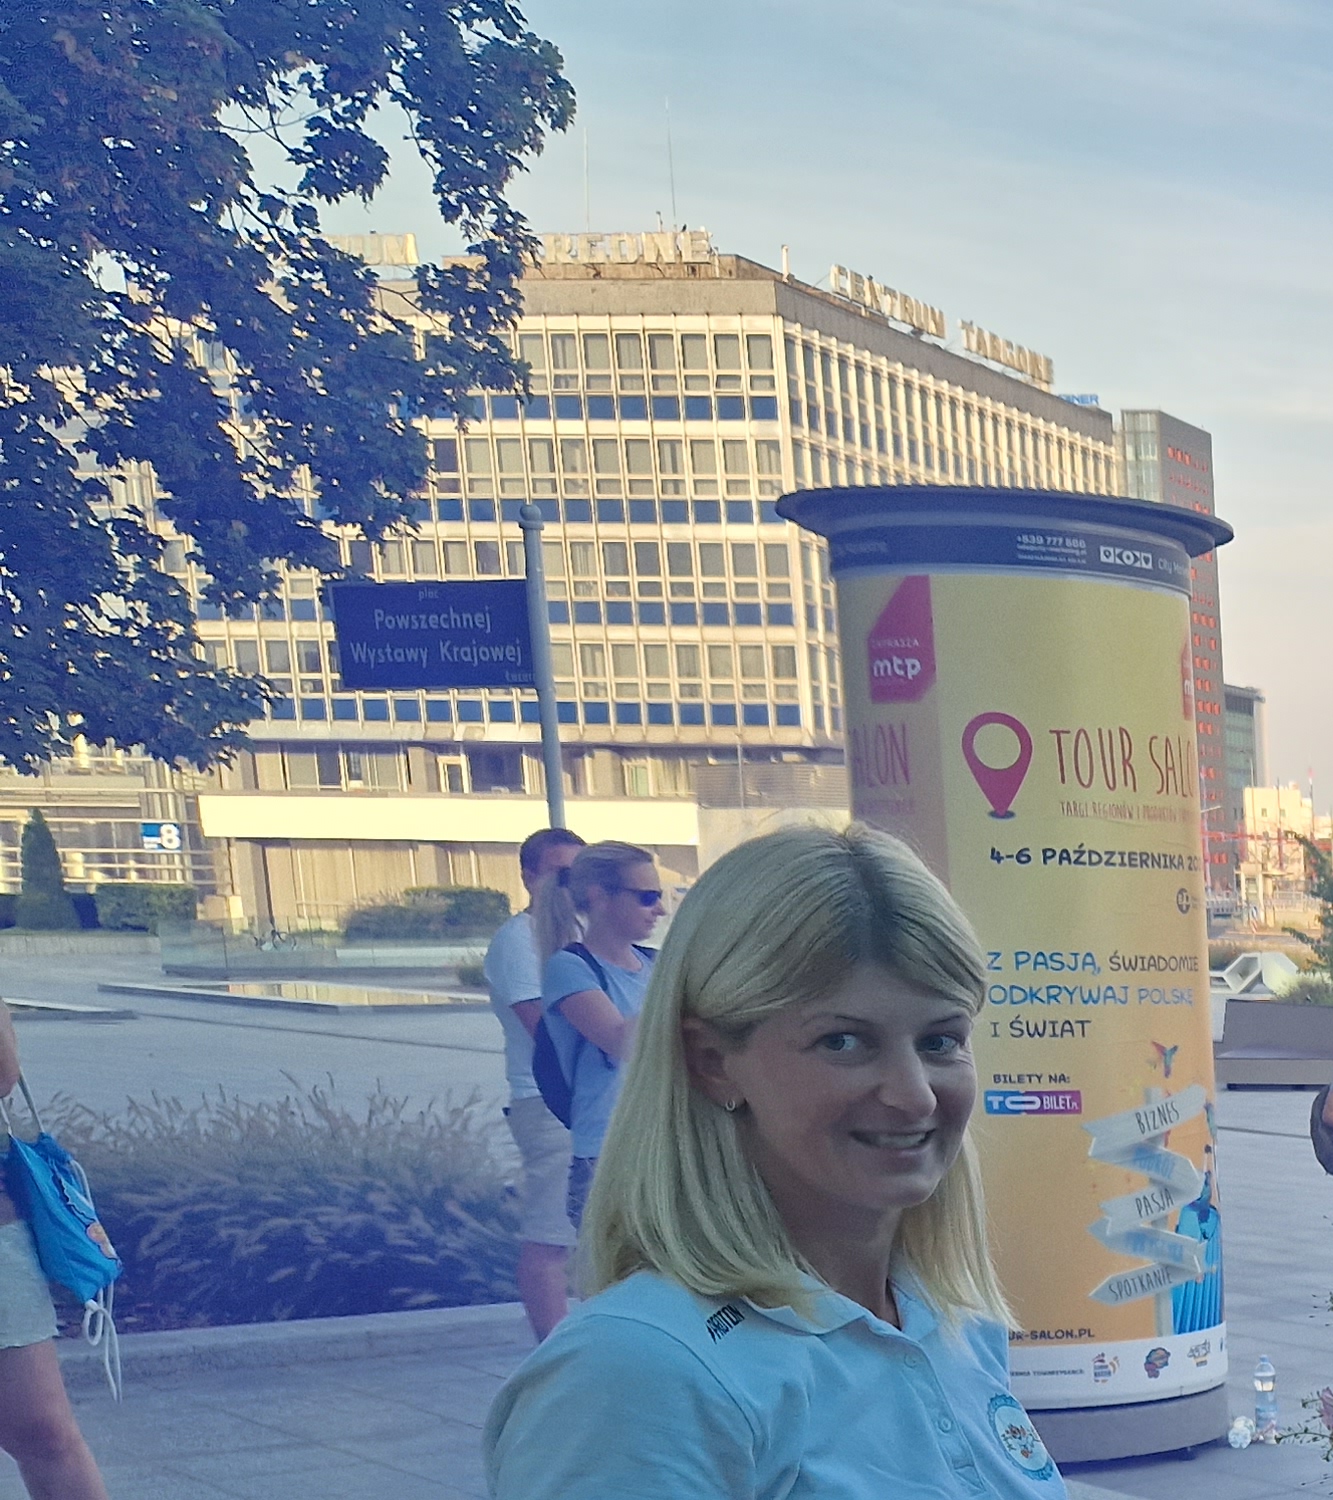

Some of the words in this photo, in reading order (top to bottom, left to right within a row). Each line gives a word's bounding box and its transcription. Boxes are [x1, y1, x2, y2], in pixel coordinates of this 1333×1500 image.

[374, 605, 492, 634] Powszechnej
[349, 641, 429, 669] Wystawy
[439, 638, 522, 668] Krajowej
[872, 655, 922, 681] mtp
[850, 720, 911, 788] ALON
[1048, 725, 1137, 793] TOUR
[1148, 734, 1196, 798] SALO
[989, 847, 1032, 864] 4-6
[1042, 842, 1185, 870] PAŹDZIERNIKA
[986, 951, 1002, 971] Z
[1014, 951, 1101, 976] PASJĄ,
[1108, 949, 1199, 973] ŚWIADOMIE
[988, 984, 1129, 1006] ODKRYWAJ
[990, 1021, 1000, 1038] I
[1009, 1014, 1092, 1039] ŚWIAT
[992, 1073, 1043, 1084] BILETY
[1048, 1073, 1071, 1084] NA:
[1135, 1101, 1180, 1135] BIZNES
[1135, 1187, 1174, 1219] PASJA
[1108, 1265, 1174, 1302] SPOTKANIE
